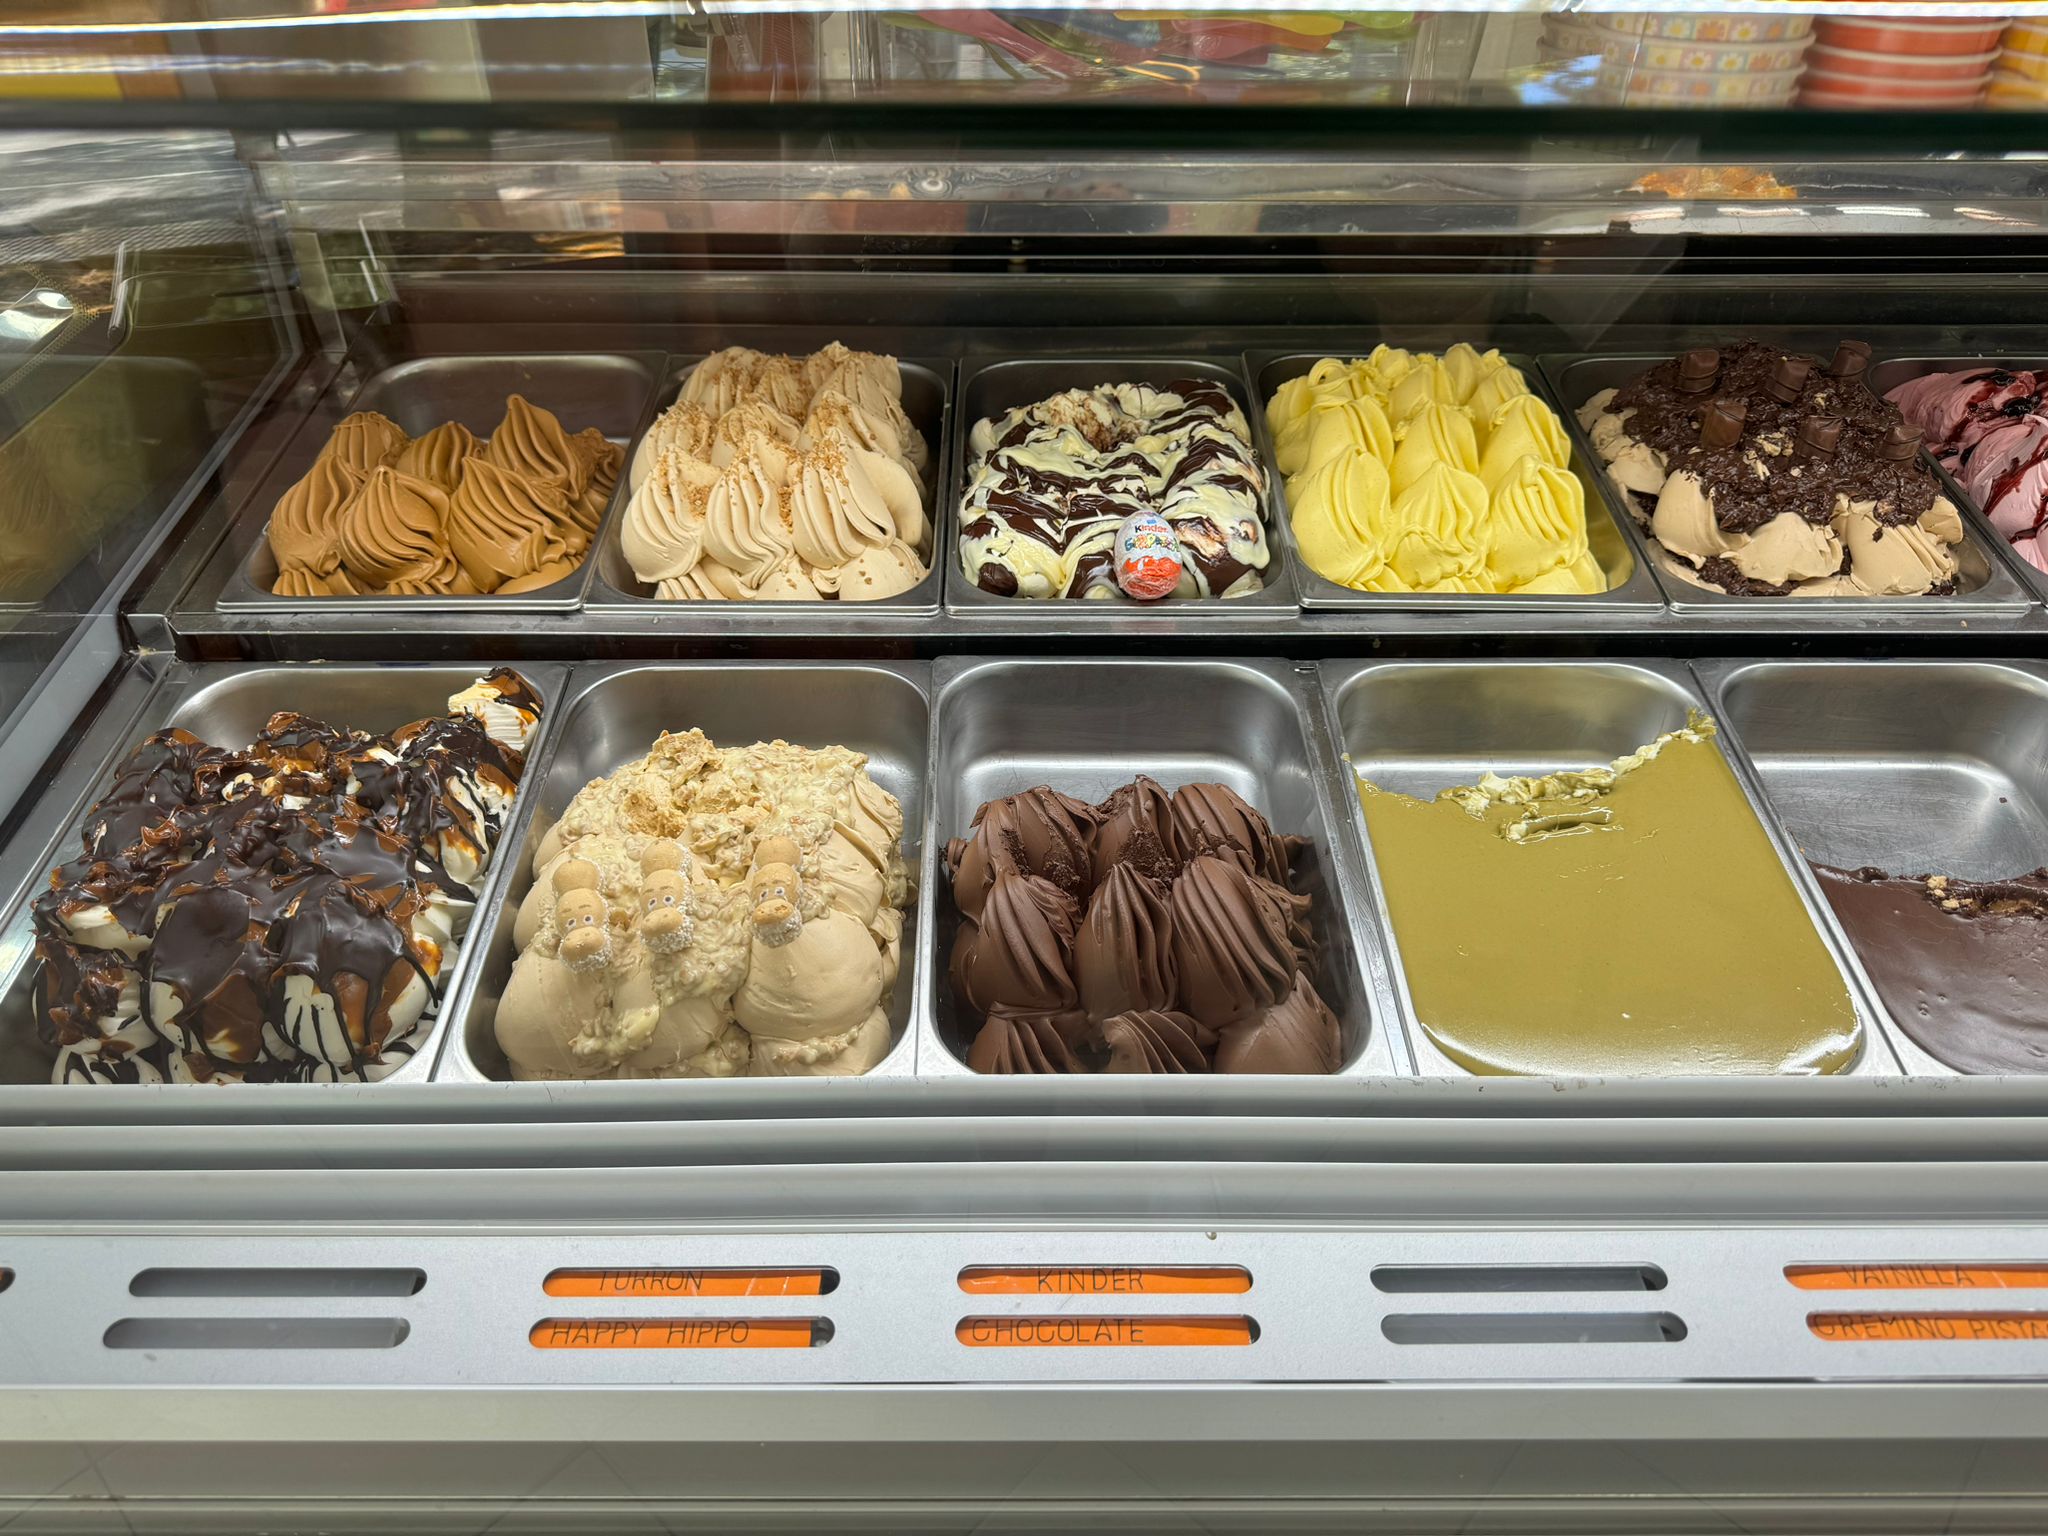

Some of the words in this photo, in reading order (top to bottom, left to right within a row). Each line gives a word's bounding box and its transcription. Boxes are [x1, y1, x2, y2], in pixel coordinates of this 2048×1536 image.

[1037, 1268, 1145, 1292] KINDER
[1841, 1265, 1975, 1285] VAINILLA
[551, 1320, 648, 1345] HAPPY
[667, 1320, 750, 1345] HIPPO
[972, 1319, 1145, 1343] CHOCOLATE
[1967, 1318, 2048, 1340] PISTA
